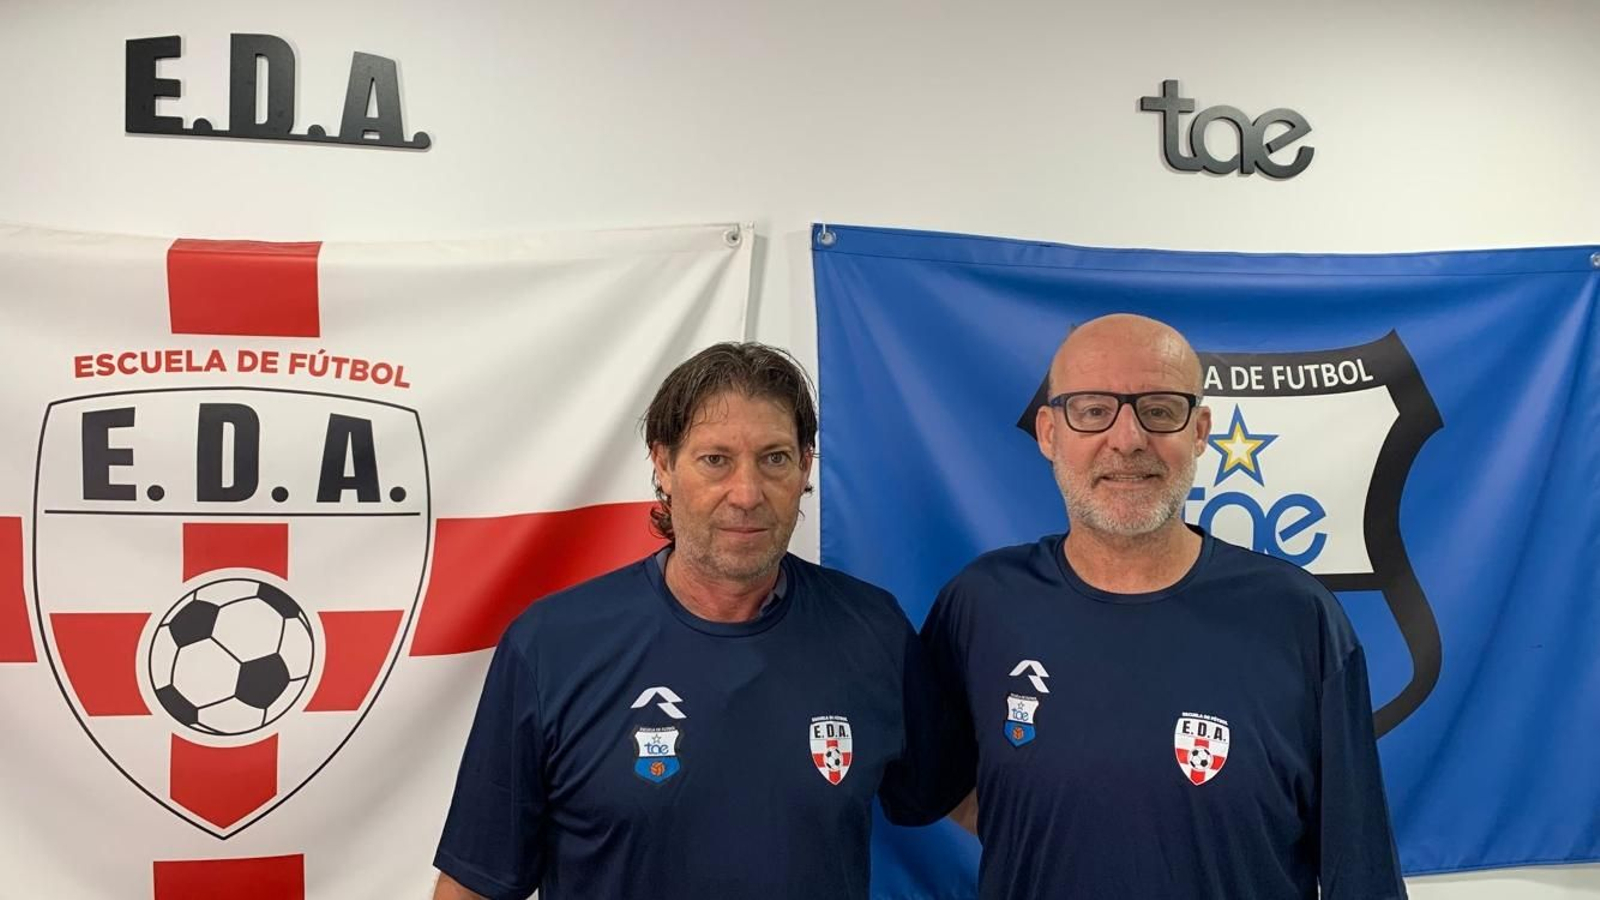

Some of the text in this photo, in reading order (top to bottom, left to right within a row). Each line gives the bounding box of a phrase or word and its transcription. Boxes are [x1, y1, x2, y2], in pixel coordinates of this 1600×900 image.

[125, 33, 431, 149] E.D.A.
[1140, 79, 1315, 179] tae
[74, 349, 411, 389] ESCUELA DE FÚTBOL
[1230, 365, 1265, 390] DE
[1272, 358, 1374, 390] FUTBOL
[643, 742, 670, 755] tae
